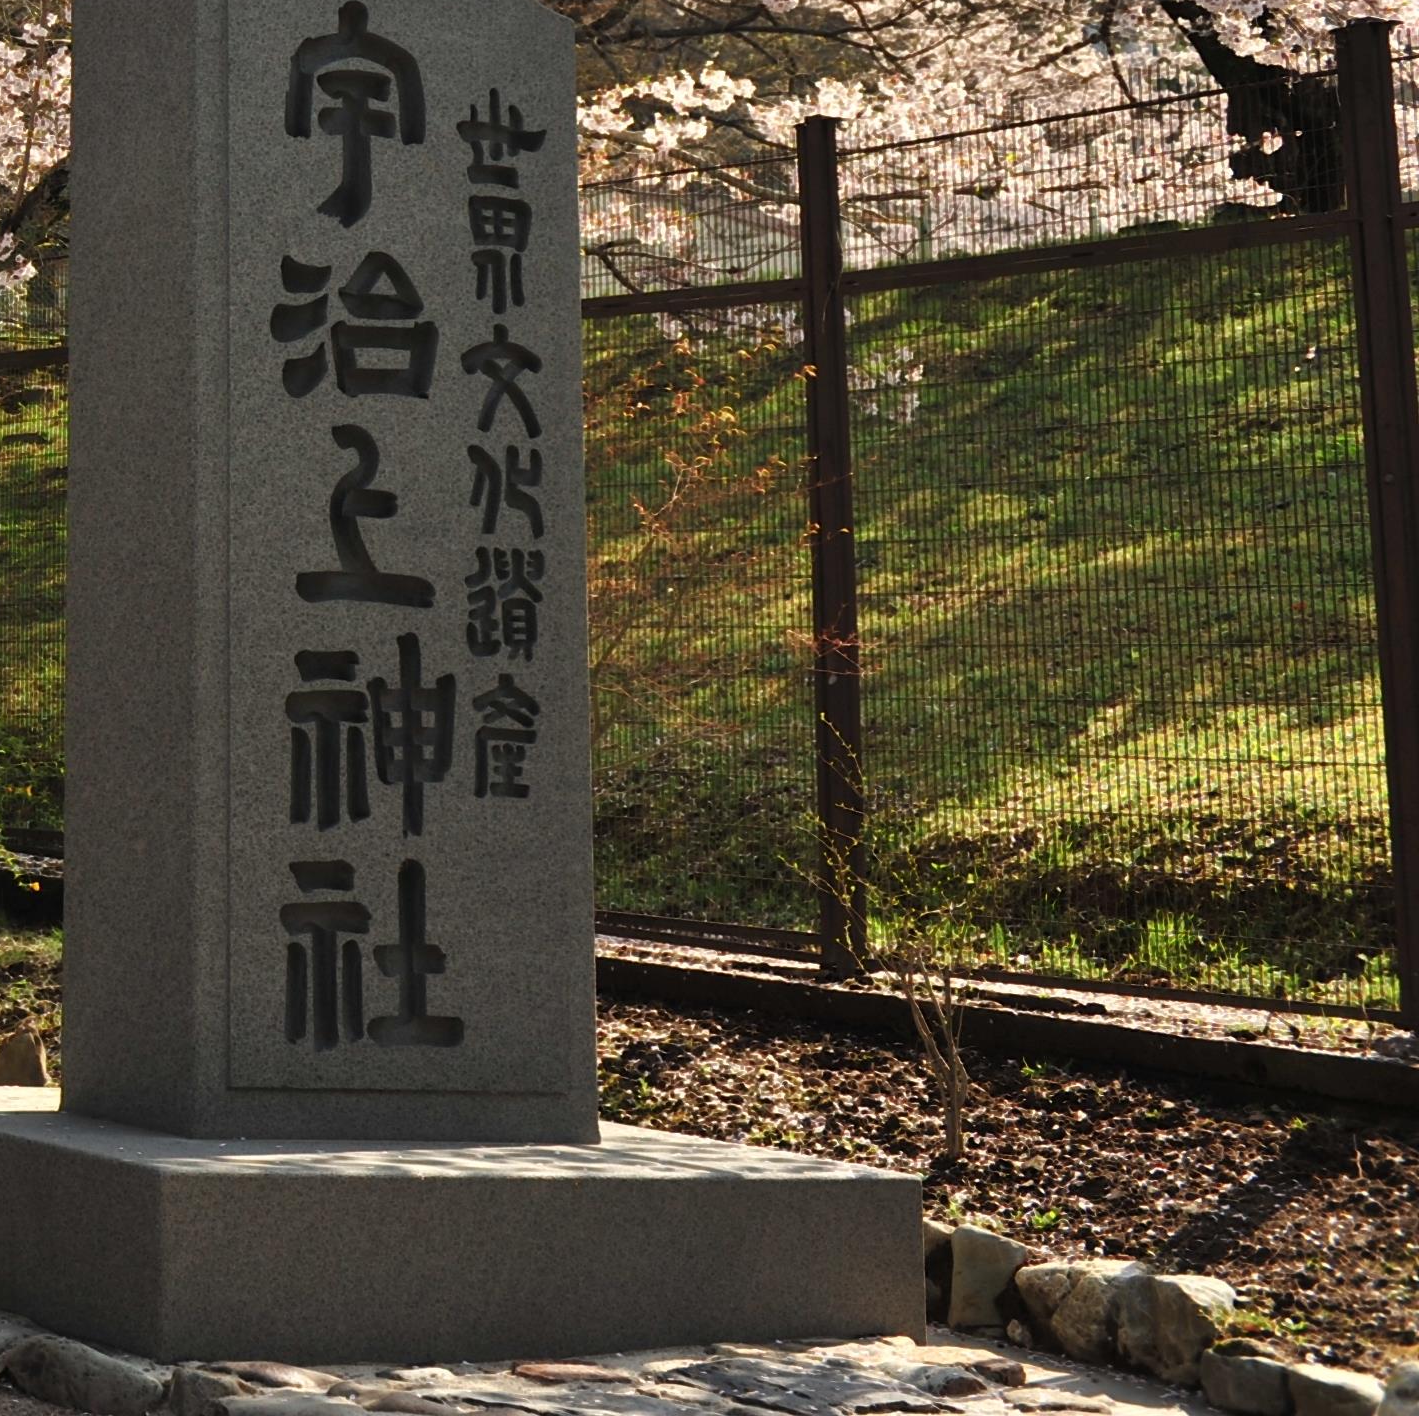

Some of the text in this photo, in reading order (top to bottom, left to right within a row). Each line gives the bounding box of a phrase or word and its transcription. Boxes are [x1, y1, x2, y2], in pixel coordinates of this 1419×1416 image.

[271, 0, 464, 1051] 宇治上神社
